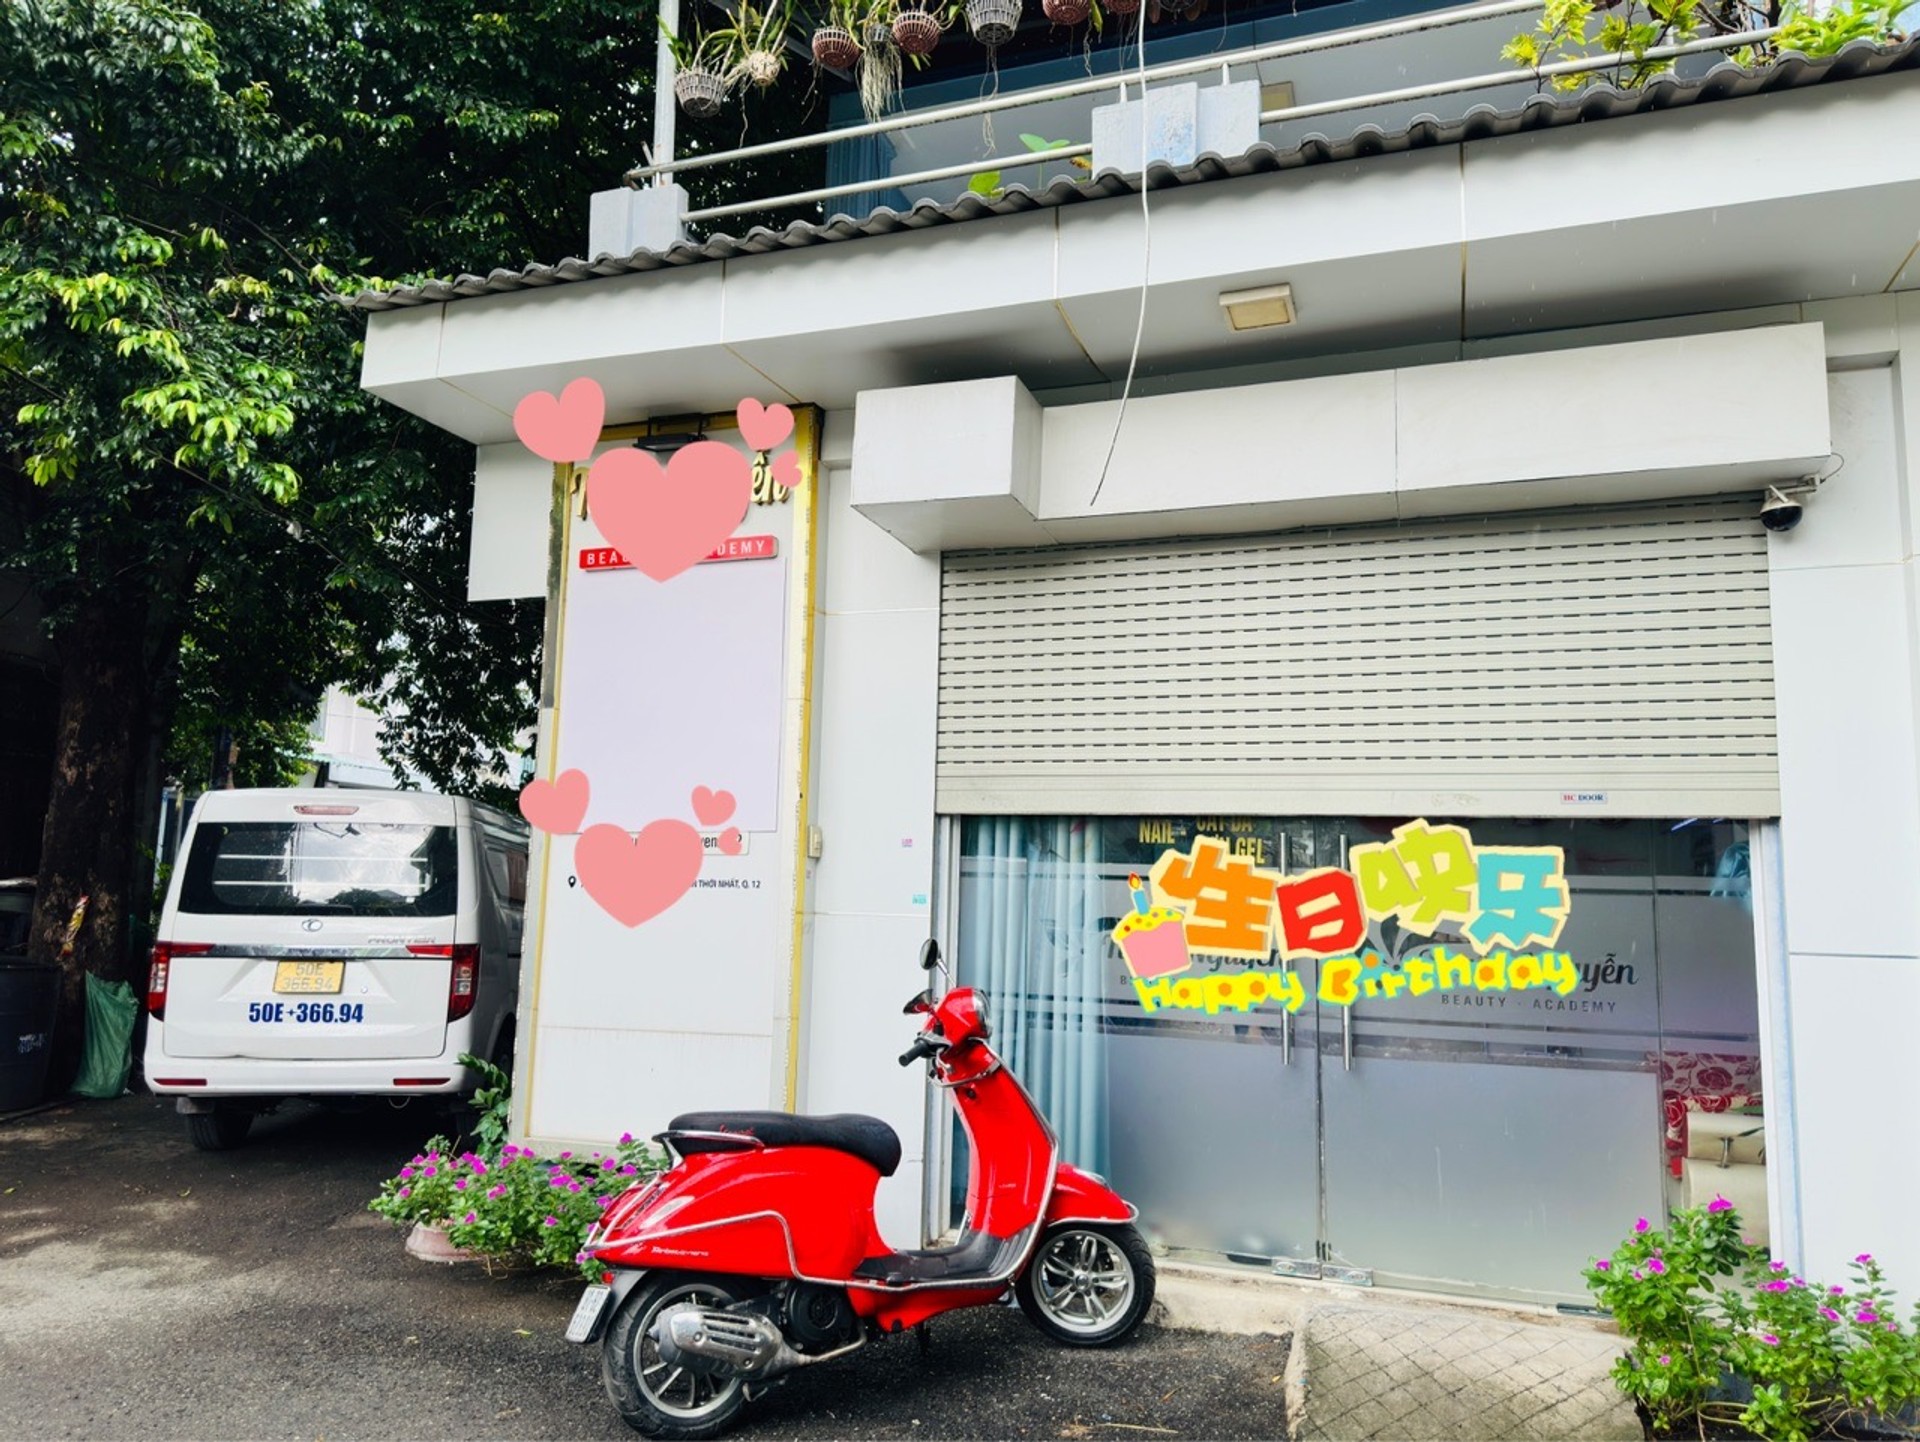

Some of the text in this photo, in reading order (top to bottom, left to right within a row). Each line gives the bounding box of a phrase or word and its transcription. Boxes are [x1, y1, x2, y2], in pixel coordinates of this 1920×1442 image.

[586, 539, 765, 565] BEA DEMY
[1139, 820, 1175, 844] NAIL
[1235, 836, 1265, 864] GEL
[752, 880, 761, 890] 12
[296, 960, 324, 976] 50E
[1441, 994, 1507, 1008] BEAUTY
[1532, 998, 1617, 1014] ACADEMY
